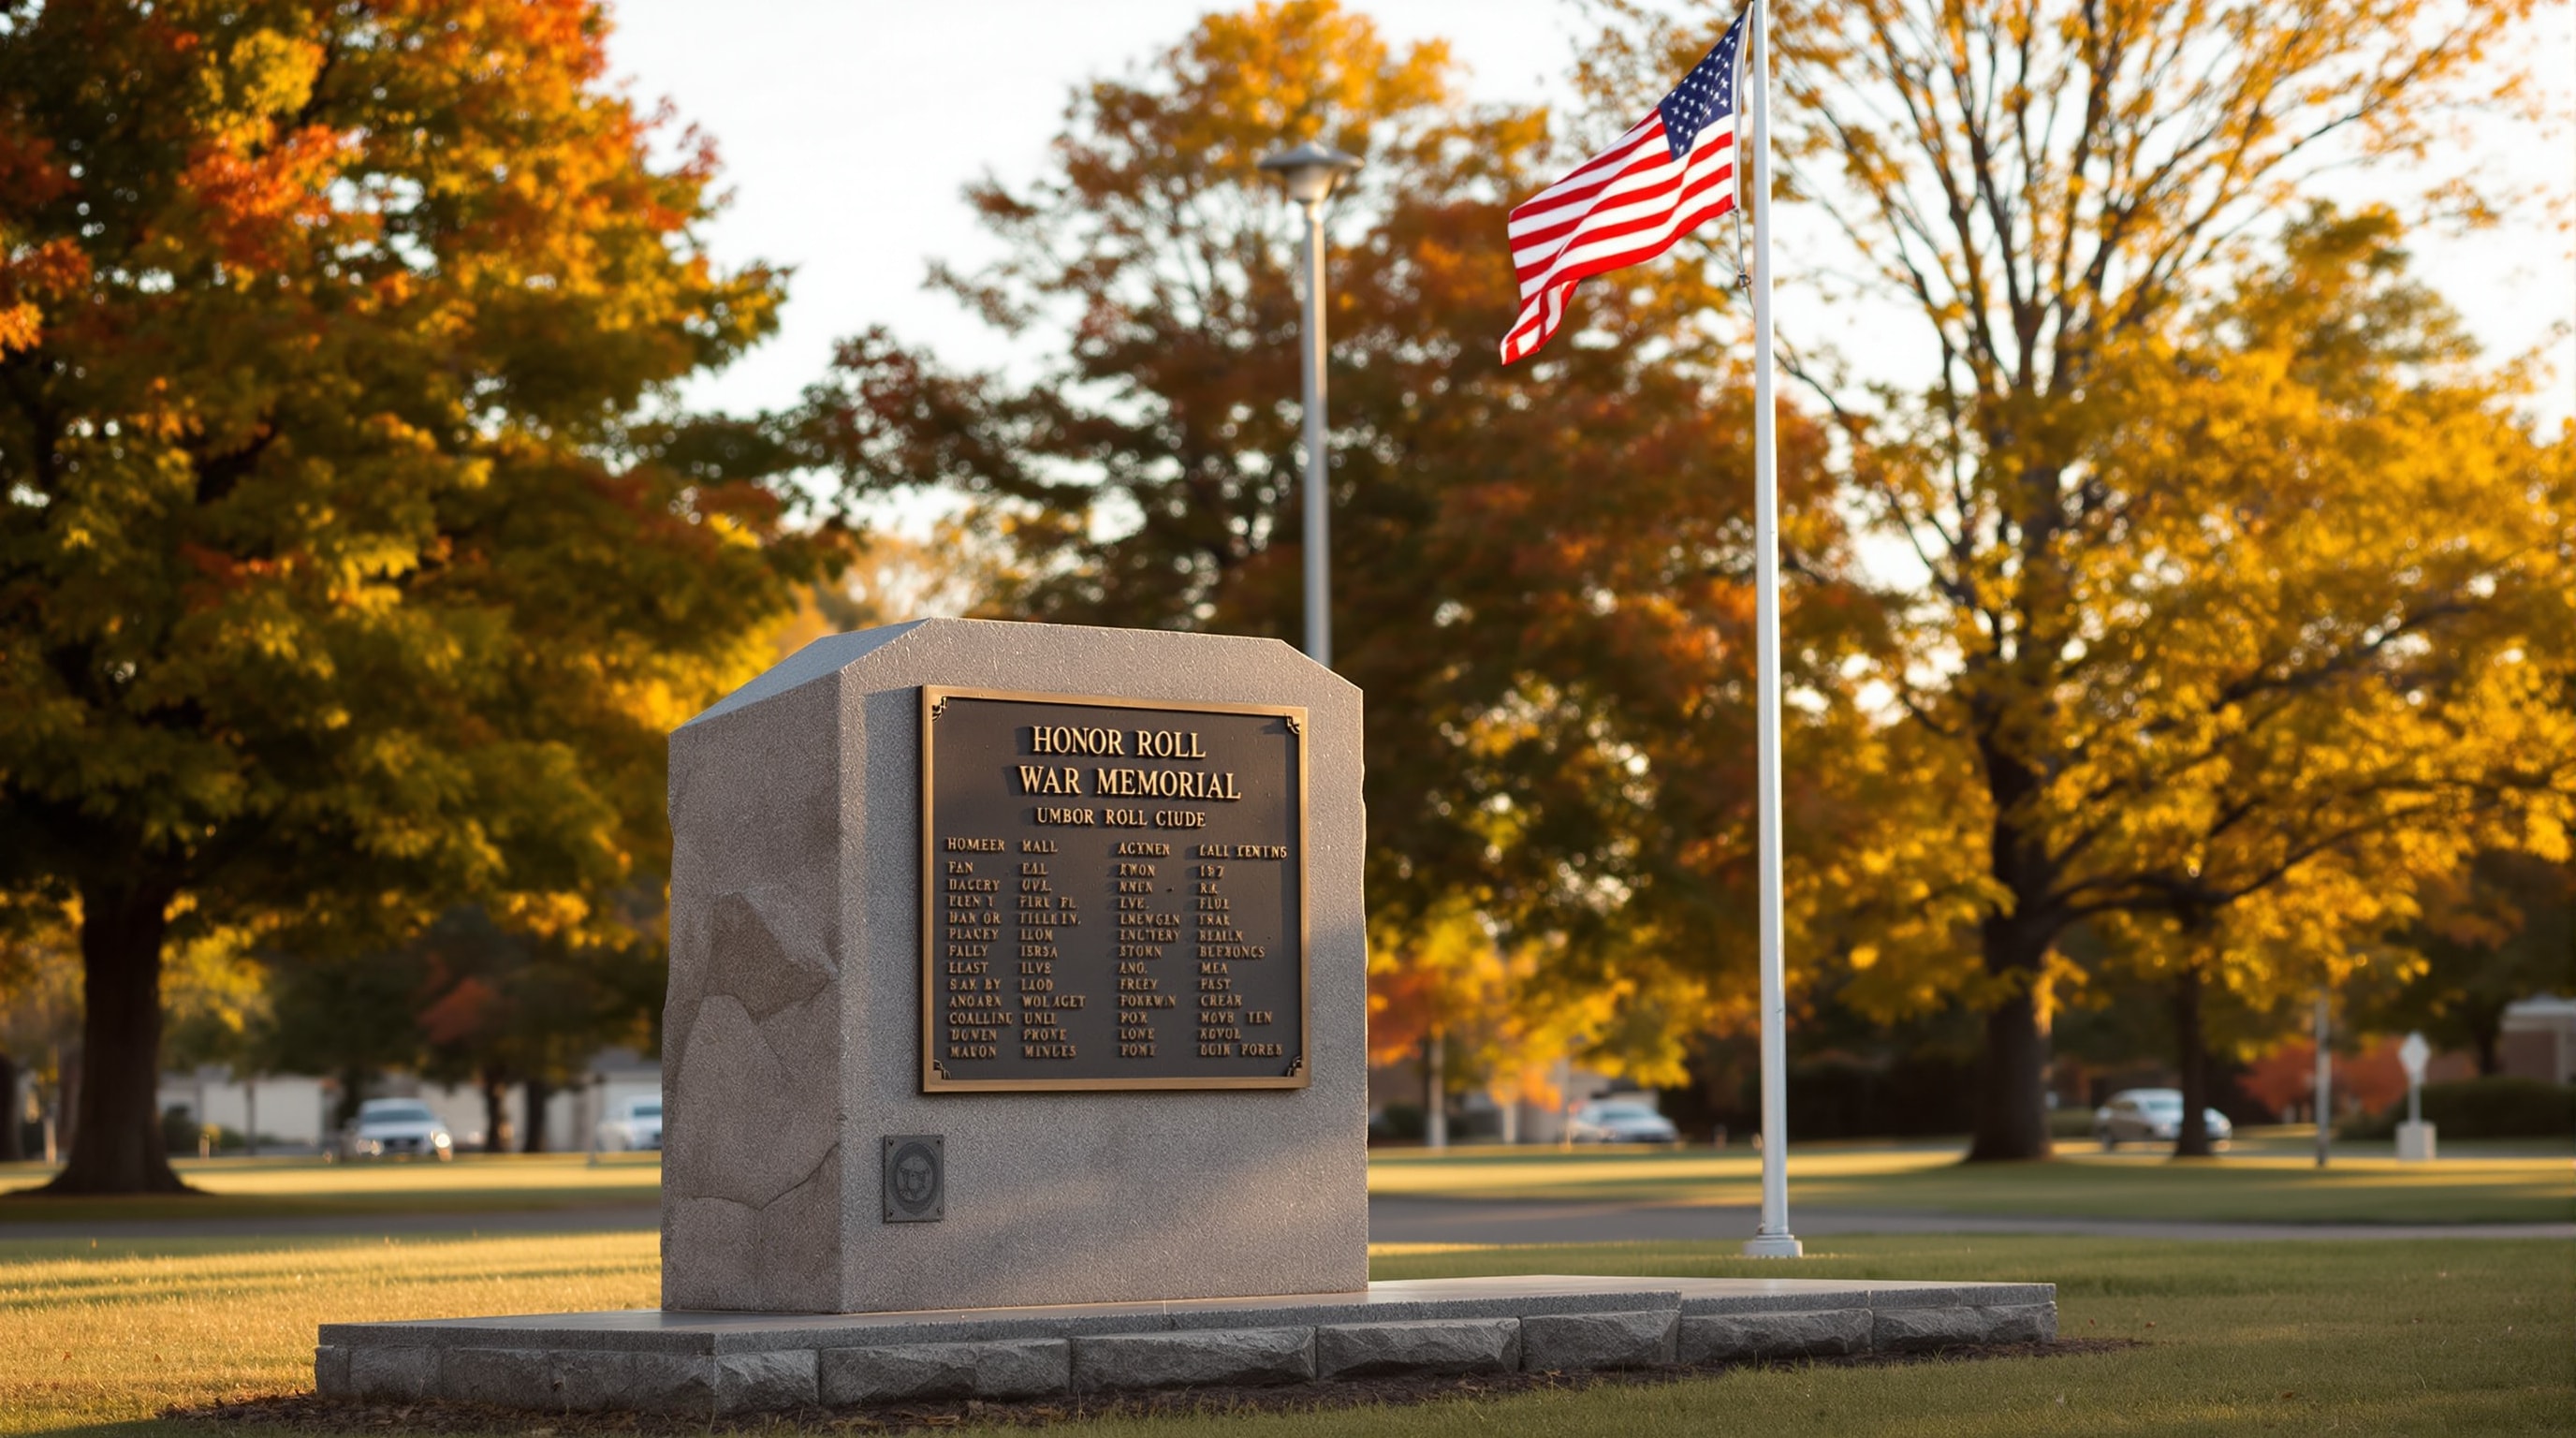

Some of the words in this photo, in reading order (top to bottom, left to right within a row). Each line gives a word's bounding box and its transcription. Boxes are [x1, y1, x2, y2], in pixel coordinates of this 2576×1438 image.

[1032, 726, 1125, 756] HONOR
[1136, 730, 1207, 758] ROLL
[1018, 765, 1081, 795] WAR
[1096, 768, 1242, 800] MEMORIAL
[1036, 807, 1095, 825] UMBOR
[1105, 809, 1148, 826] ROLL
